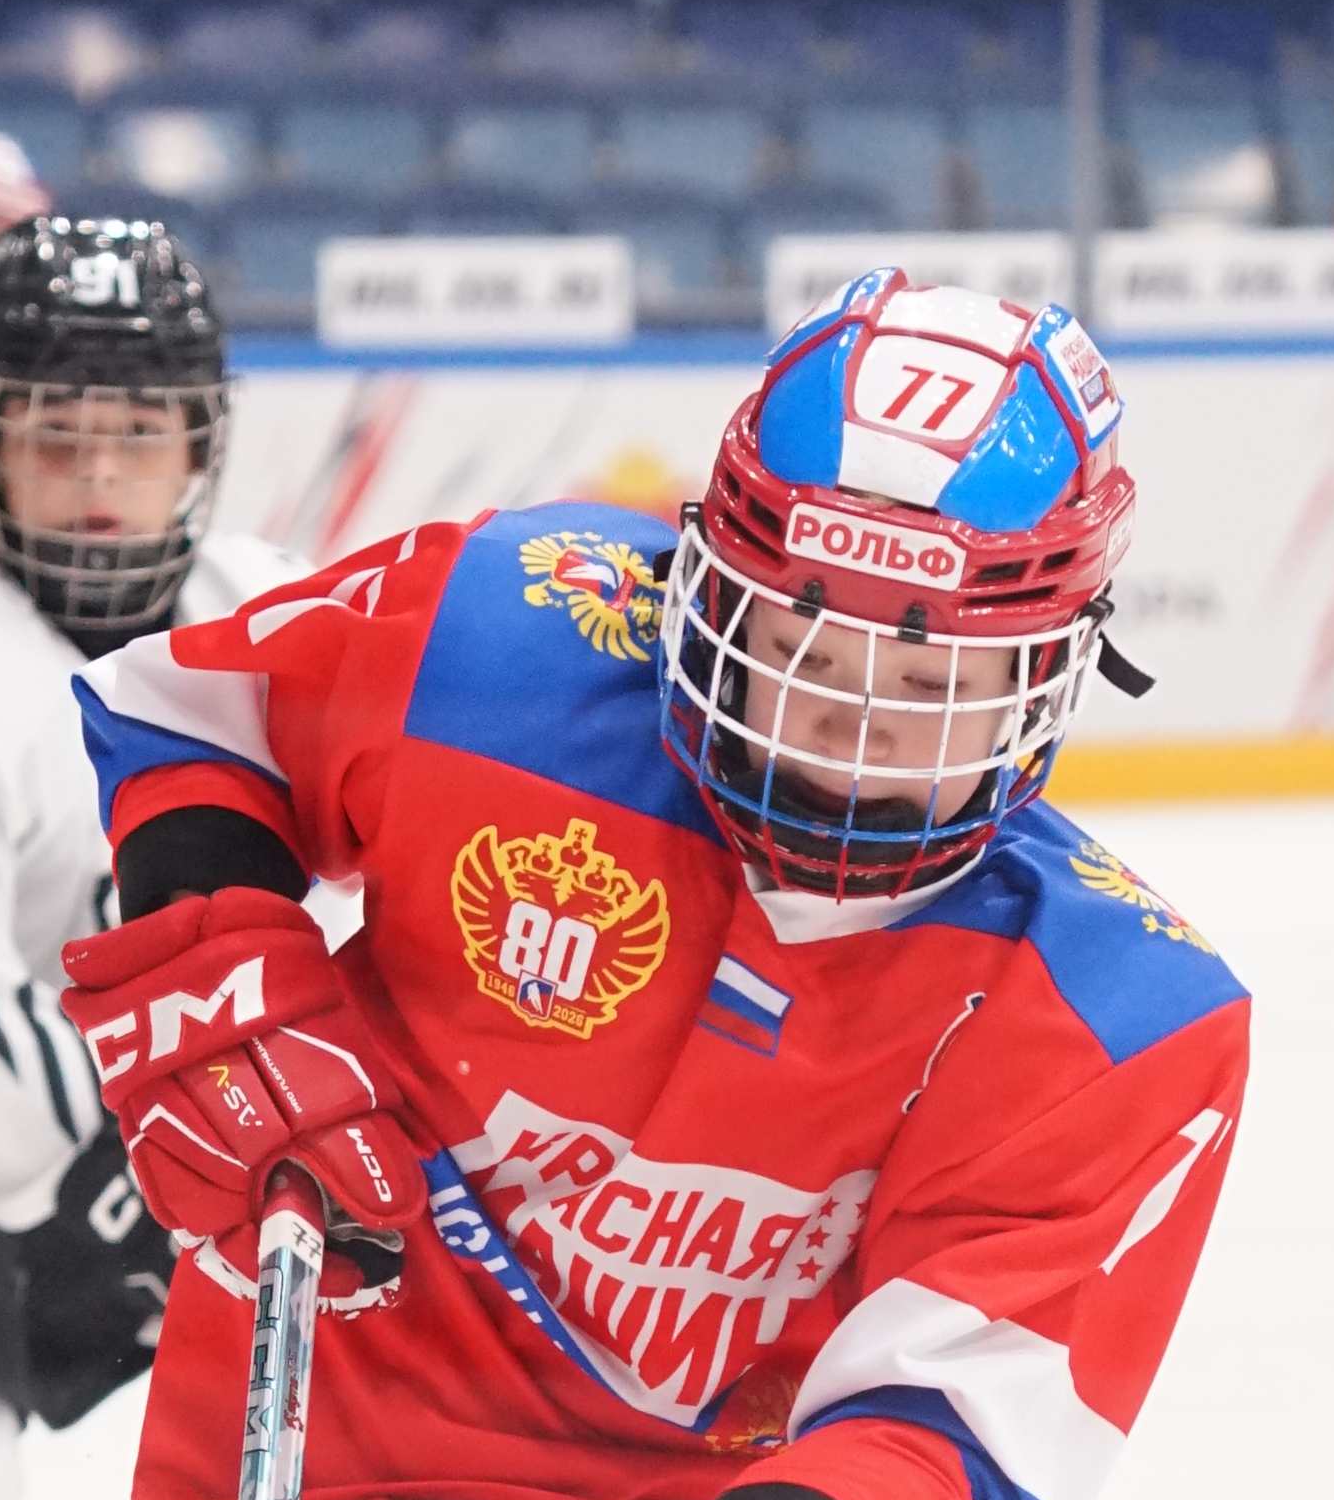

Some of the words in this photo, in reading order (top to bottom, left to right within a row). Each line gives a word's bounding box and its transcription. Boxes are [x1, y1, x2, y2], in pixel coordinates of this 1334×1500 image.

[70, 251, 141, 308] 91
[881, 364, 976, 431] 77
[791, 513, 957, 577] РОЛЬФ
[499, 899, 598, 1001] 80
[346, 1127, 393, 1204] CCM
